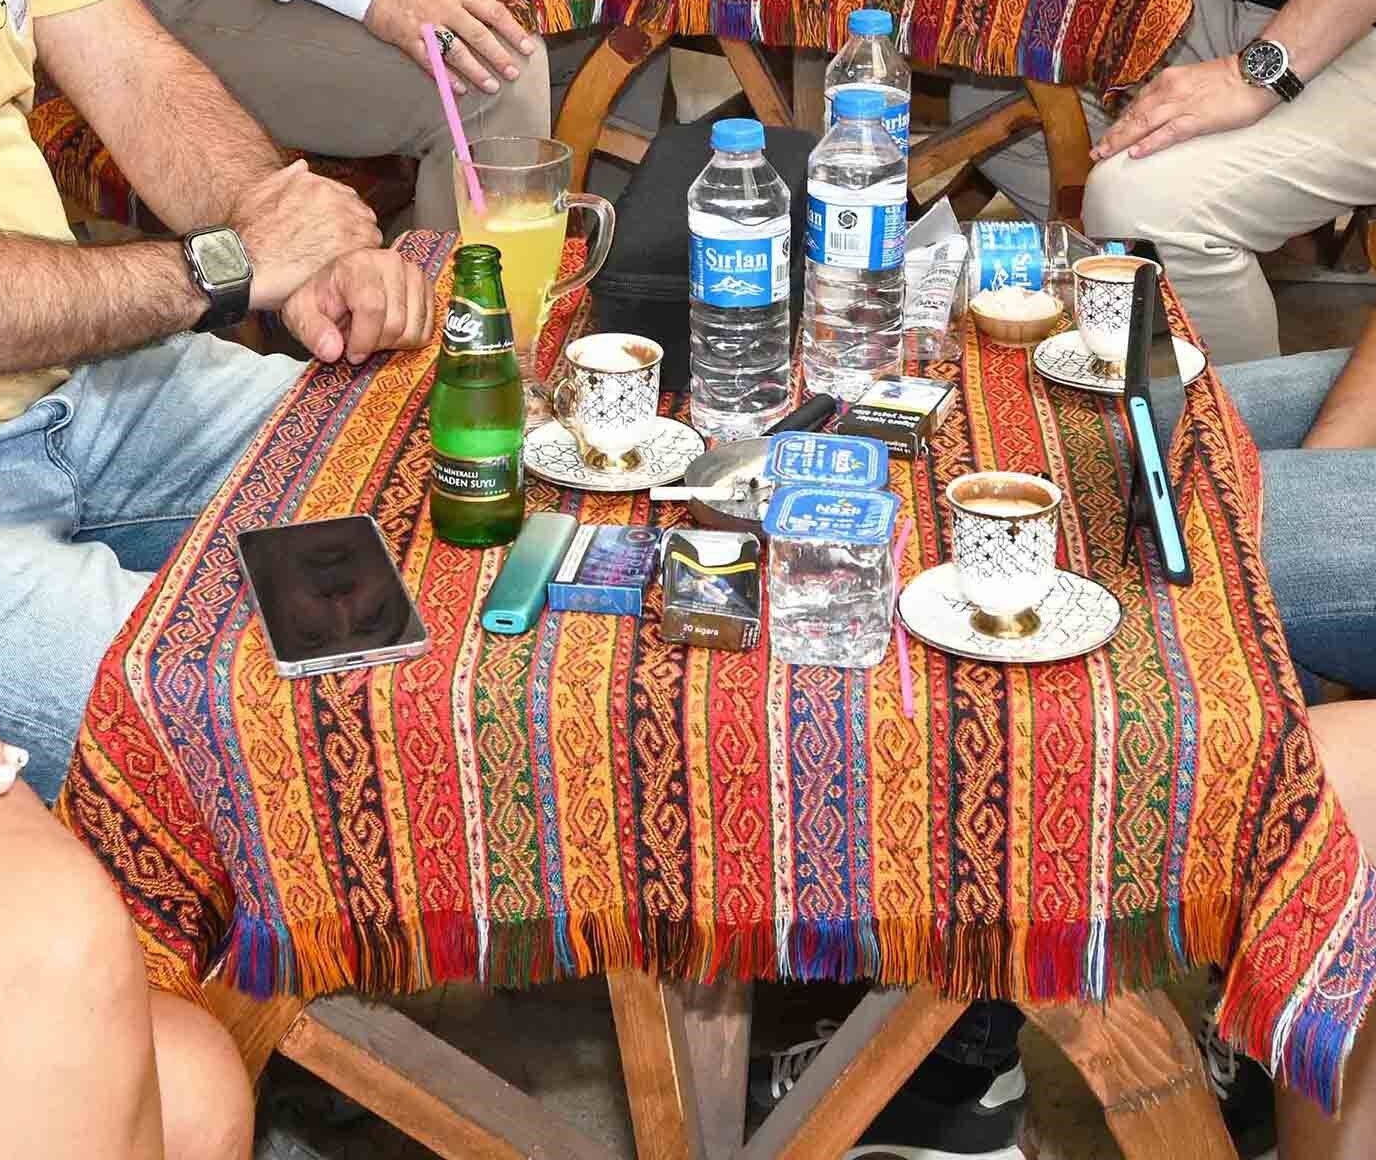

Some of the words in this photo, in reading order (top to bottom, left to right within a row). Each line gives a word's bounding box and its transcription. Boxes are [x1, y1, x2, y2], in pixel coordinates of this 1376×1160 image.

[438, 472, 468, 488] MADEN
[470, 479, 496, 489] SUYU
[683, 623, 693, 633] 20
[694, 625, 720, 636] sigara
